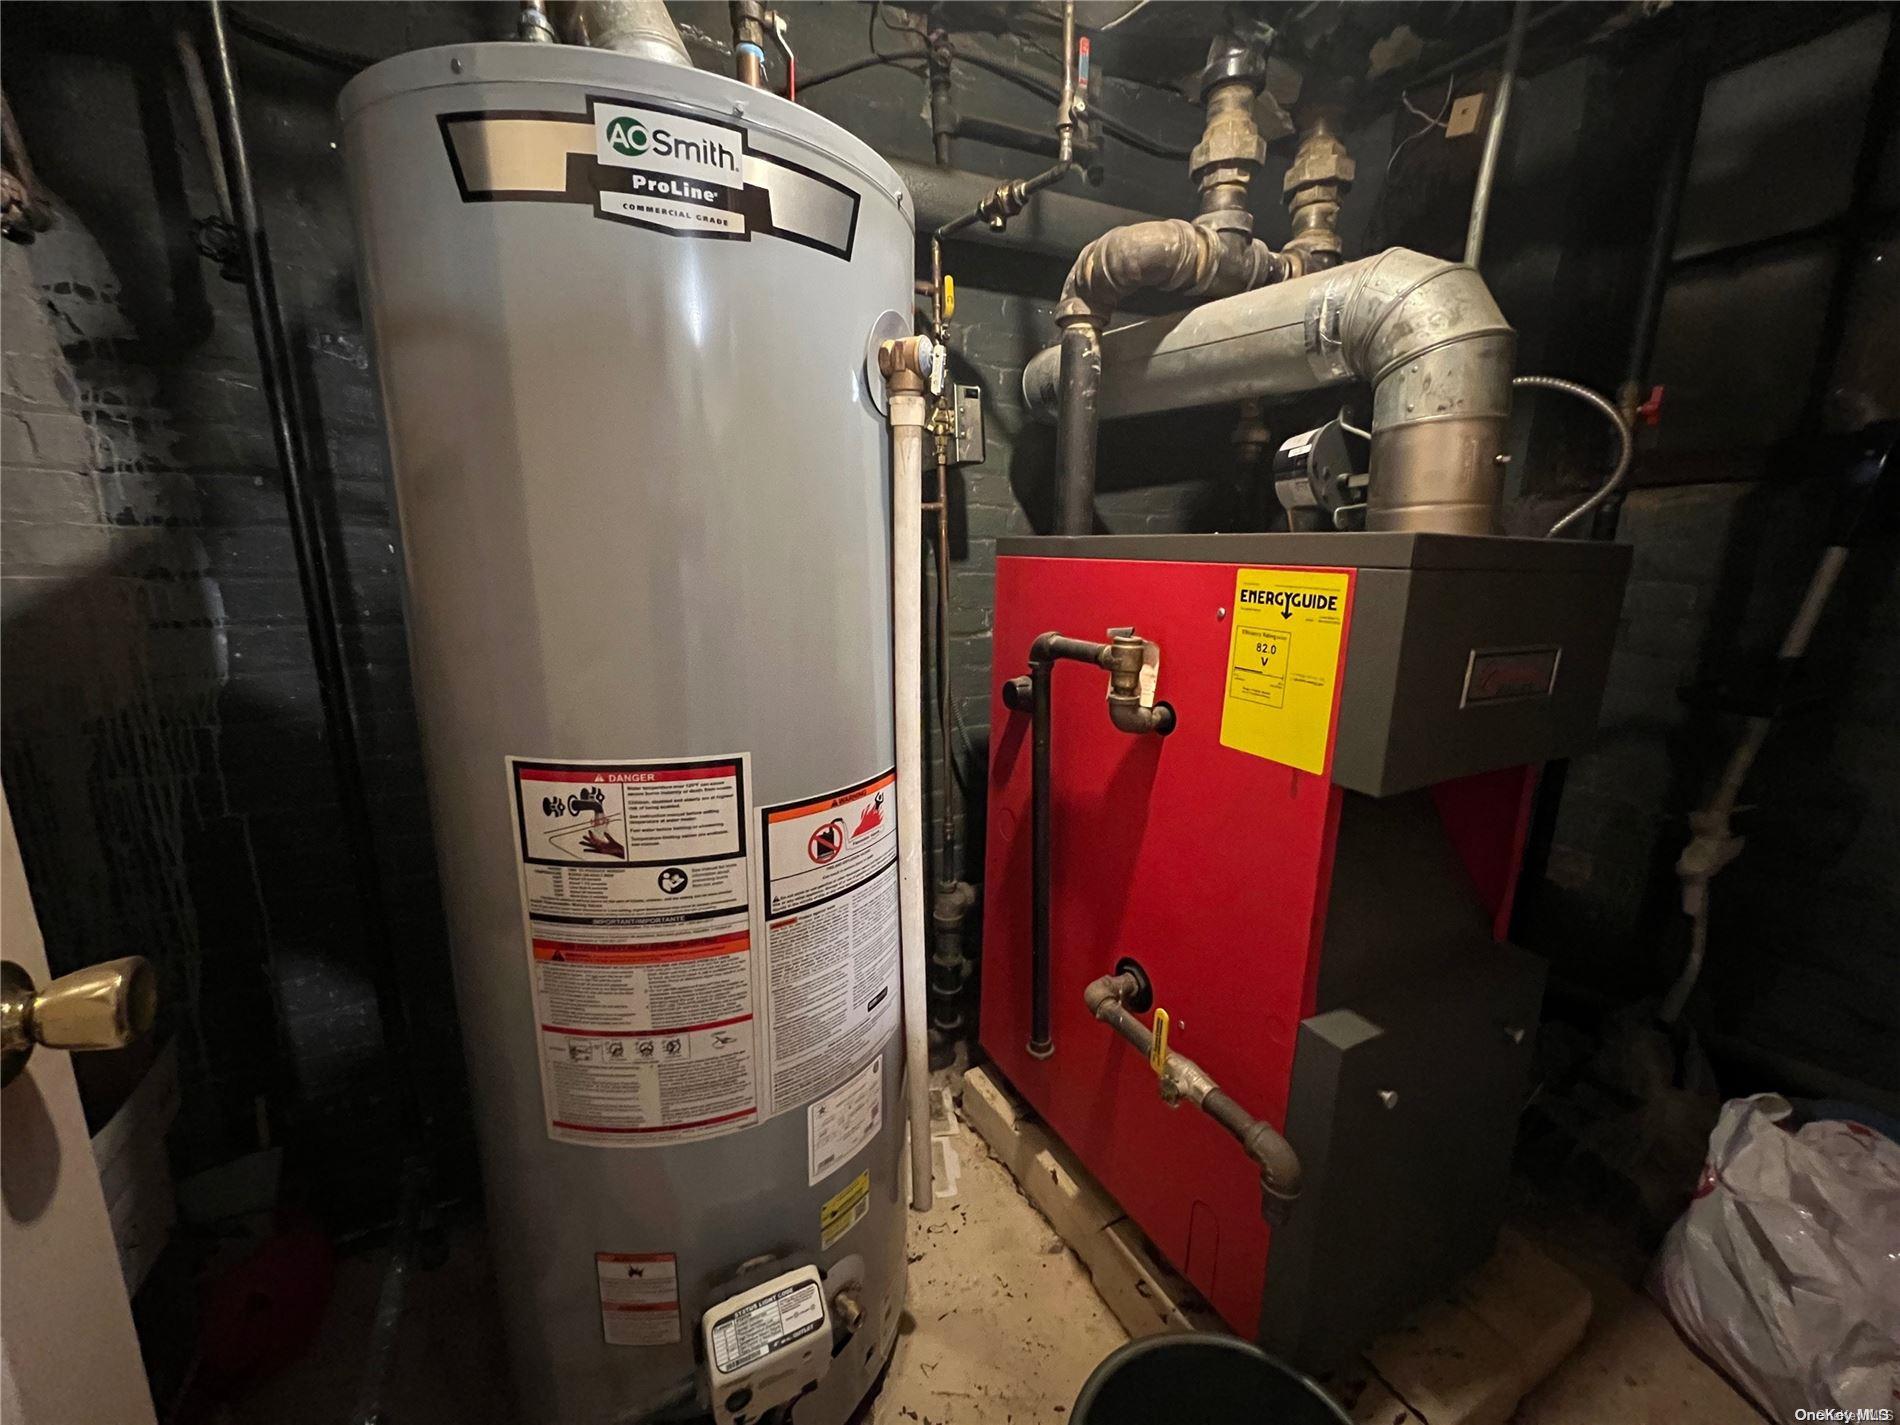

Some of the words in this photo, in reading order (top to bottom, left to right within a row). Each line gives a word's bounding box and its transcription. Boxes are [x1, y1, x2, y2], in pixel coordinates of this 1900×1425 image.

[632, 174, 715, 202] ProLine
[622, 202, 692, 219] COMMERCIAL
[696, 214, 729, 226] GRADE
[1240, 589, 1338, 611] ENERGYGUIDE
[1256, 642, 1277, 655] 82.0
[608, 773, 655, 782] DANGER
[839, 789, 867, 806] WARNING
[734, 1304, 757, 1318] STATUS
[758, 1294, 777, 1308] LIGHT
